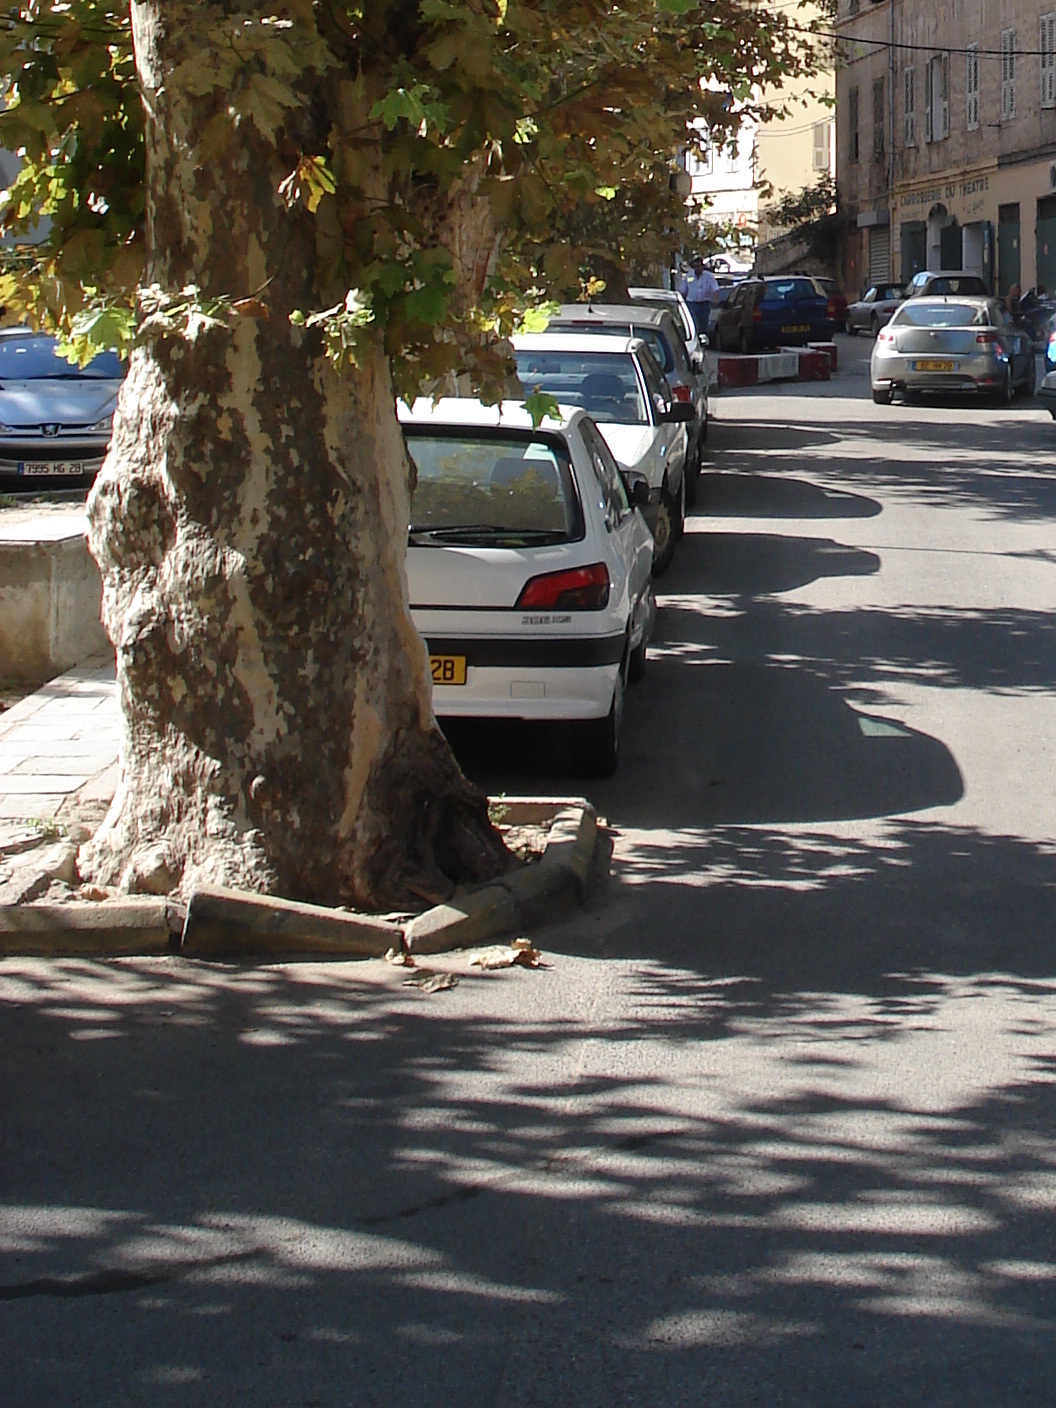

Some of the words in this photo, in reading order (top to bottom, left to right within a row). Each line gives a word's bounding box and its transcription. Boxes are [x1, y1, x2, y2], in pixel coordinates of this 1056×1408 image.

[945, 184, 955, 199] DU
[53, 463, 65, 473] HG
[69, 463, 81, 473] 2B
[431, 659, 455, 681] 2B
